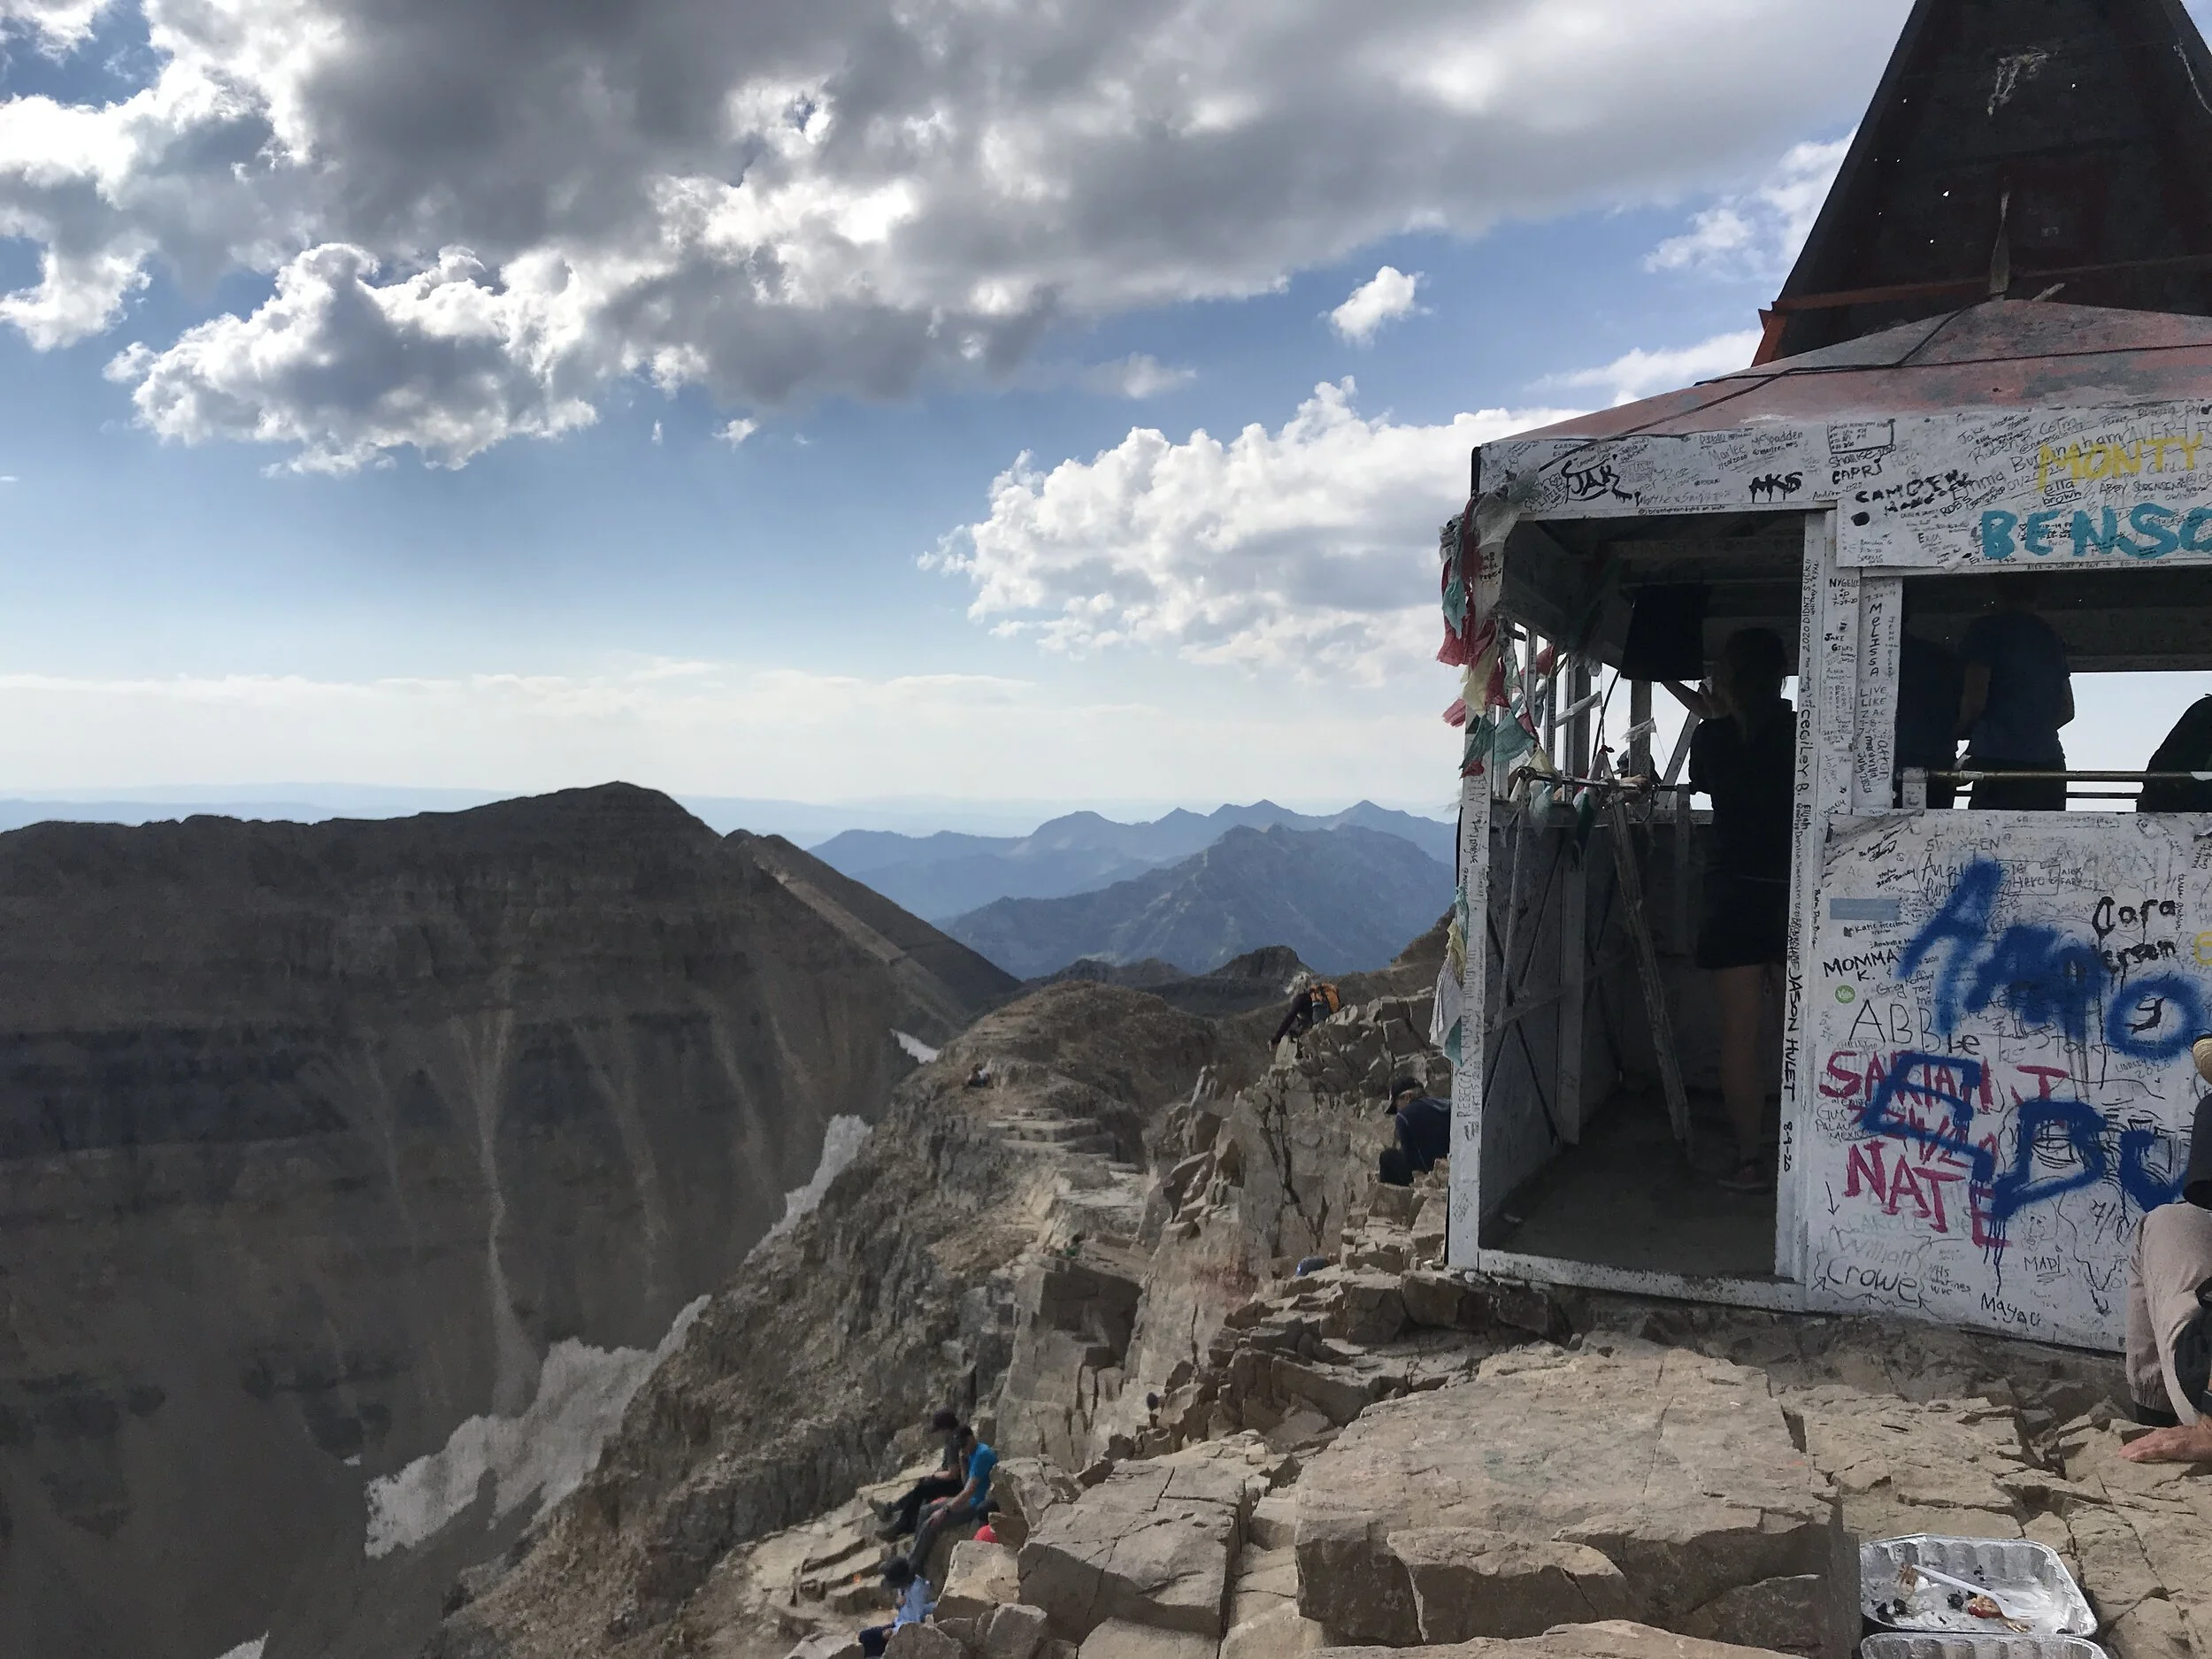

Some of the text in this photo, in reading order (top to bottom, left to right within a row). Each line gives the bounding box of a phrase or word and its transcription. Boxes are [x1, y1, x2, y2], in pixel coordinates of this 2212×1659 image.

[2044, 479, 2075, 497] ella
[1802, 627, 1811, 653] 2020
[1861, 697, 1887, 707] LIKE
[2091, 895, 2177, 941] Cora
[1823, 949, 1901, 978] MOMMA
[1857, 970, 1876, 982] K.
[1788, 968, 1803, 1033] JASON
[1827, 1256, 1918, 1302] Crowe
